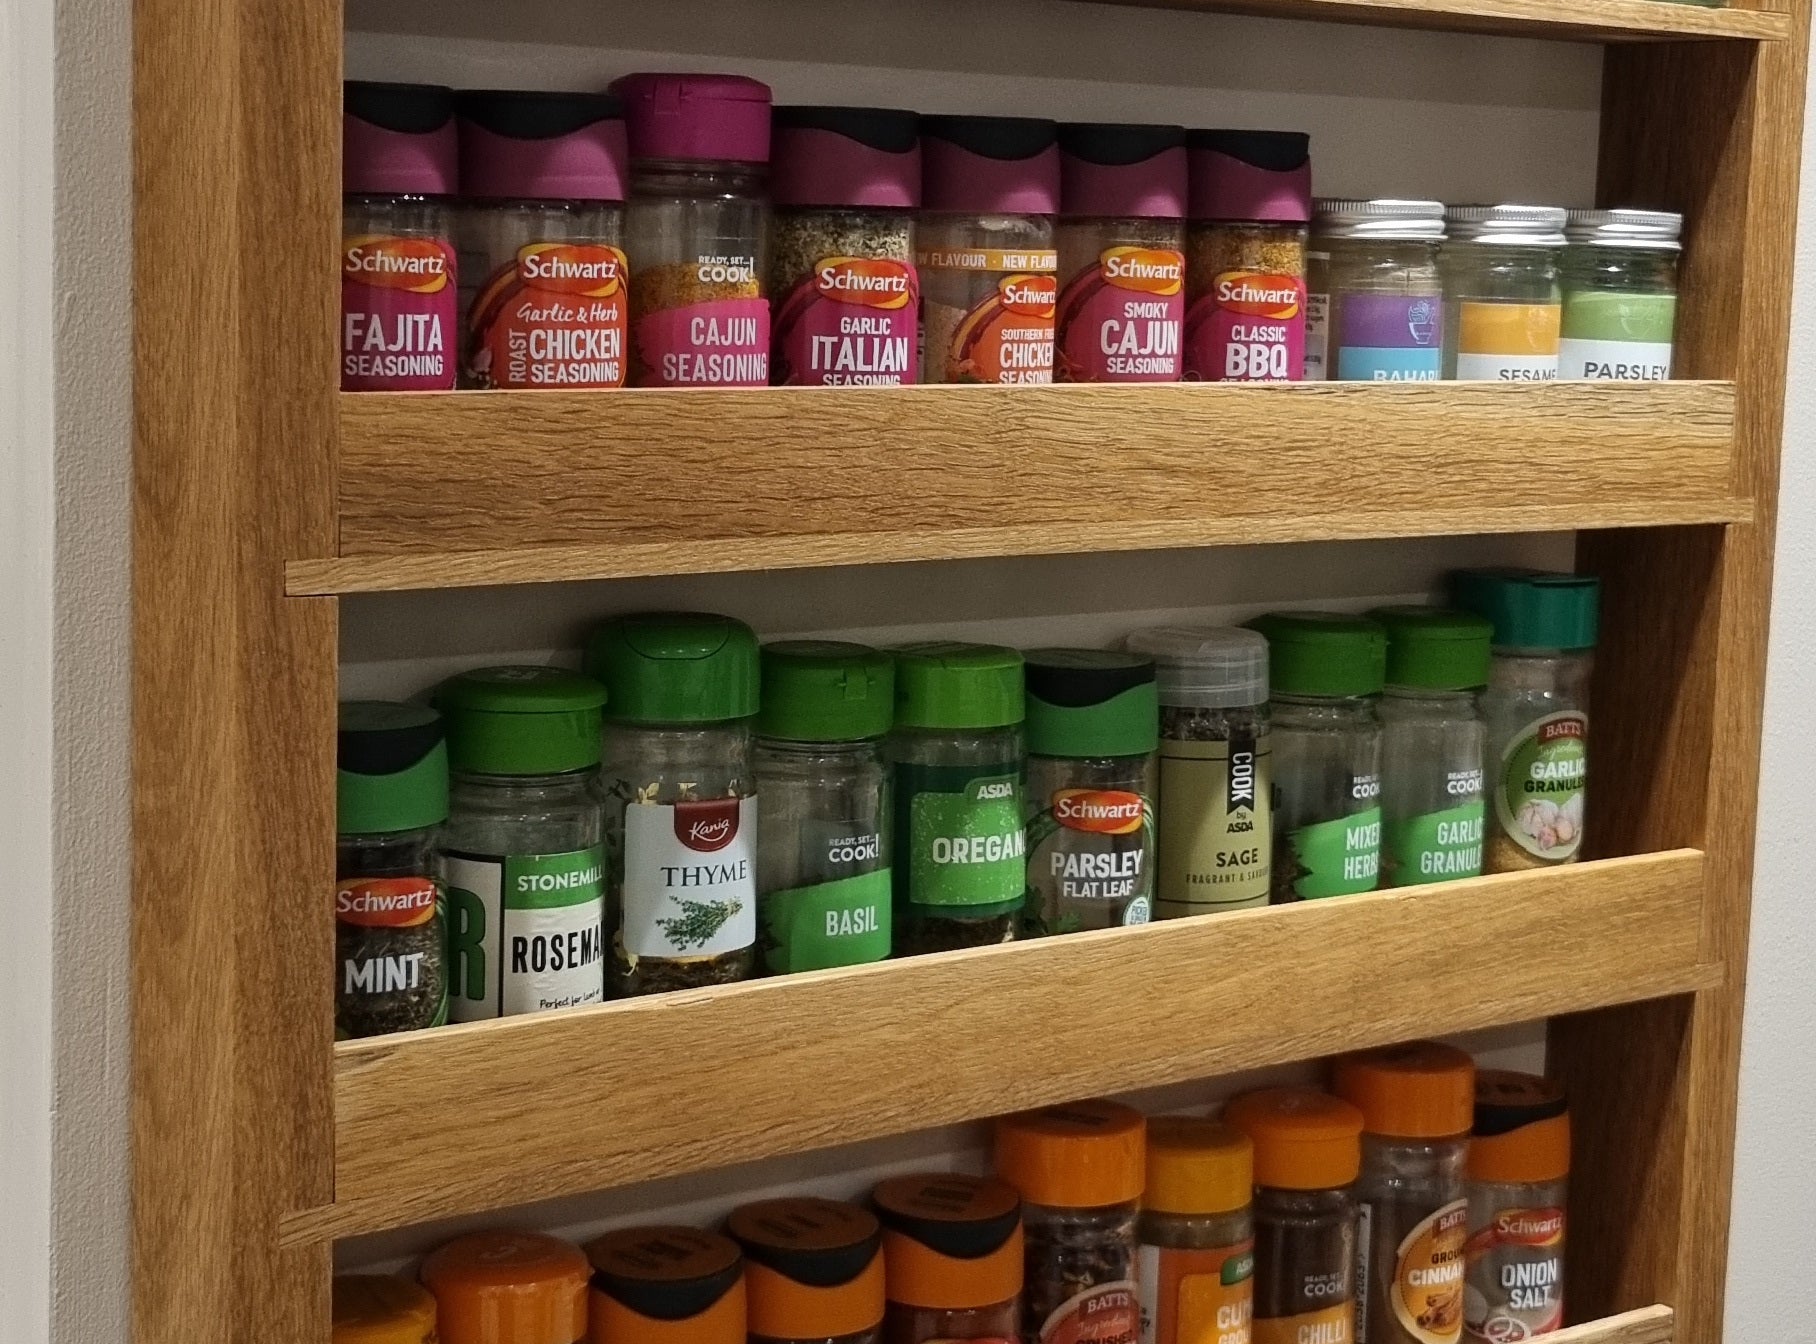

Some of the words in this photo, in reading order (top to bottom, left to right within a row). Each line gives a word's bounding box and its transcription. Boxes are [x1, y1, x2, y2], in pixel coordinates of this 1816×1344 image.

[346, 248, 444, 275] Schwartz
[523, 255, 617, 280] Schwartz
[698, 256, 729, 266] READY,
[698, 257, 754, 283] COOK!
[931, 253, 986, 267] FLAVOUR
[1003, 255, 1027, 269] NEW
[1105, 257, 1180, 279] Schwartz
[819, 268, 906, 292] Schwartz
[1218, 282, 1296, 304] Schwartz
[517, 303, 574, 323] Garlic
[577, 310, 588, 323] &
[590, 303, 618, 320] Herb
[1124, 302, 1168, 319] SMOKY
[345, 313, 443, 353] FAJITA
[691, 317, 757, 346] CAJUN
[840, 317, 891, 335] GARLIC
[1001, 328, 1043, 340] SOUTHERN
[1232, 325, 1286, 342] CLASSIC
[530, 328, 620, 360] CHICKEN
[1101, 320, 1178, 355] CAJUN
[508, 328, 527, 383] ROAST
[811, 335, 908, 372] ITALIAN
[1000, 342, 1054, 368] CHICKE
[1225, 343, 1288, 377] BBQ
[345, 355, 443, 376] SEASONING
[530, 361, 618, 384] SEASONING
[663, 353, 767, 382] SEASONING
[1106, 358, 1174, 374] SEASONING
[1584, 362, 1667, 380] PARSLEY
[823, 373, 901, 386] SEASONING
[1546, 722, 1581, 737] BATTS
[1231, 752, 1252, 802] COOK
[1530, 758, 1585, 779] GARLIC
[977, 783, 1013, 799] ASDA
[1057, 799, 1141, 819] Schwartz
[1236, 810, 1246, 820] by
[689, 818, 730, 842] Kania
[1227, 821, 1253, 833] ASDA
[829, 836, 857, 847] READY,
[829, 834, 879, 863] COOK!
[1051, 849, 1144, 877] PARSLEY
[1216, 848, 1259, 868] SAGE
[1421, 844, 1482, 874] GRANUL
[660, 860, 747, 887] THYME
[1186, 874, 1235, 884] FRAGRANT
[1063, 881, 1100, 898] FLAT
[1103, 879, 1134, 897] LEAF
[337, 890, 432, 913] Schwartz
[826, 906, 879, 937] BASIL
[512, 924, 603, 974] ROSEMA
[345, 952, 424, 995] MINT
[540, 996, 569, 1009] Perfect
[1498, 1214, 1561, 1234] Schwartz
[1502, 1258, 1558, 1287] ONION
[1088, 1293, 1129, 1314] BATTS
[1510, 1286, 1553, 1309] SALT
